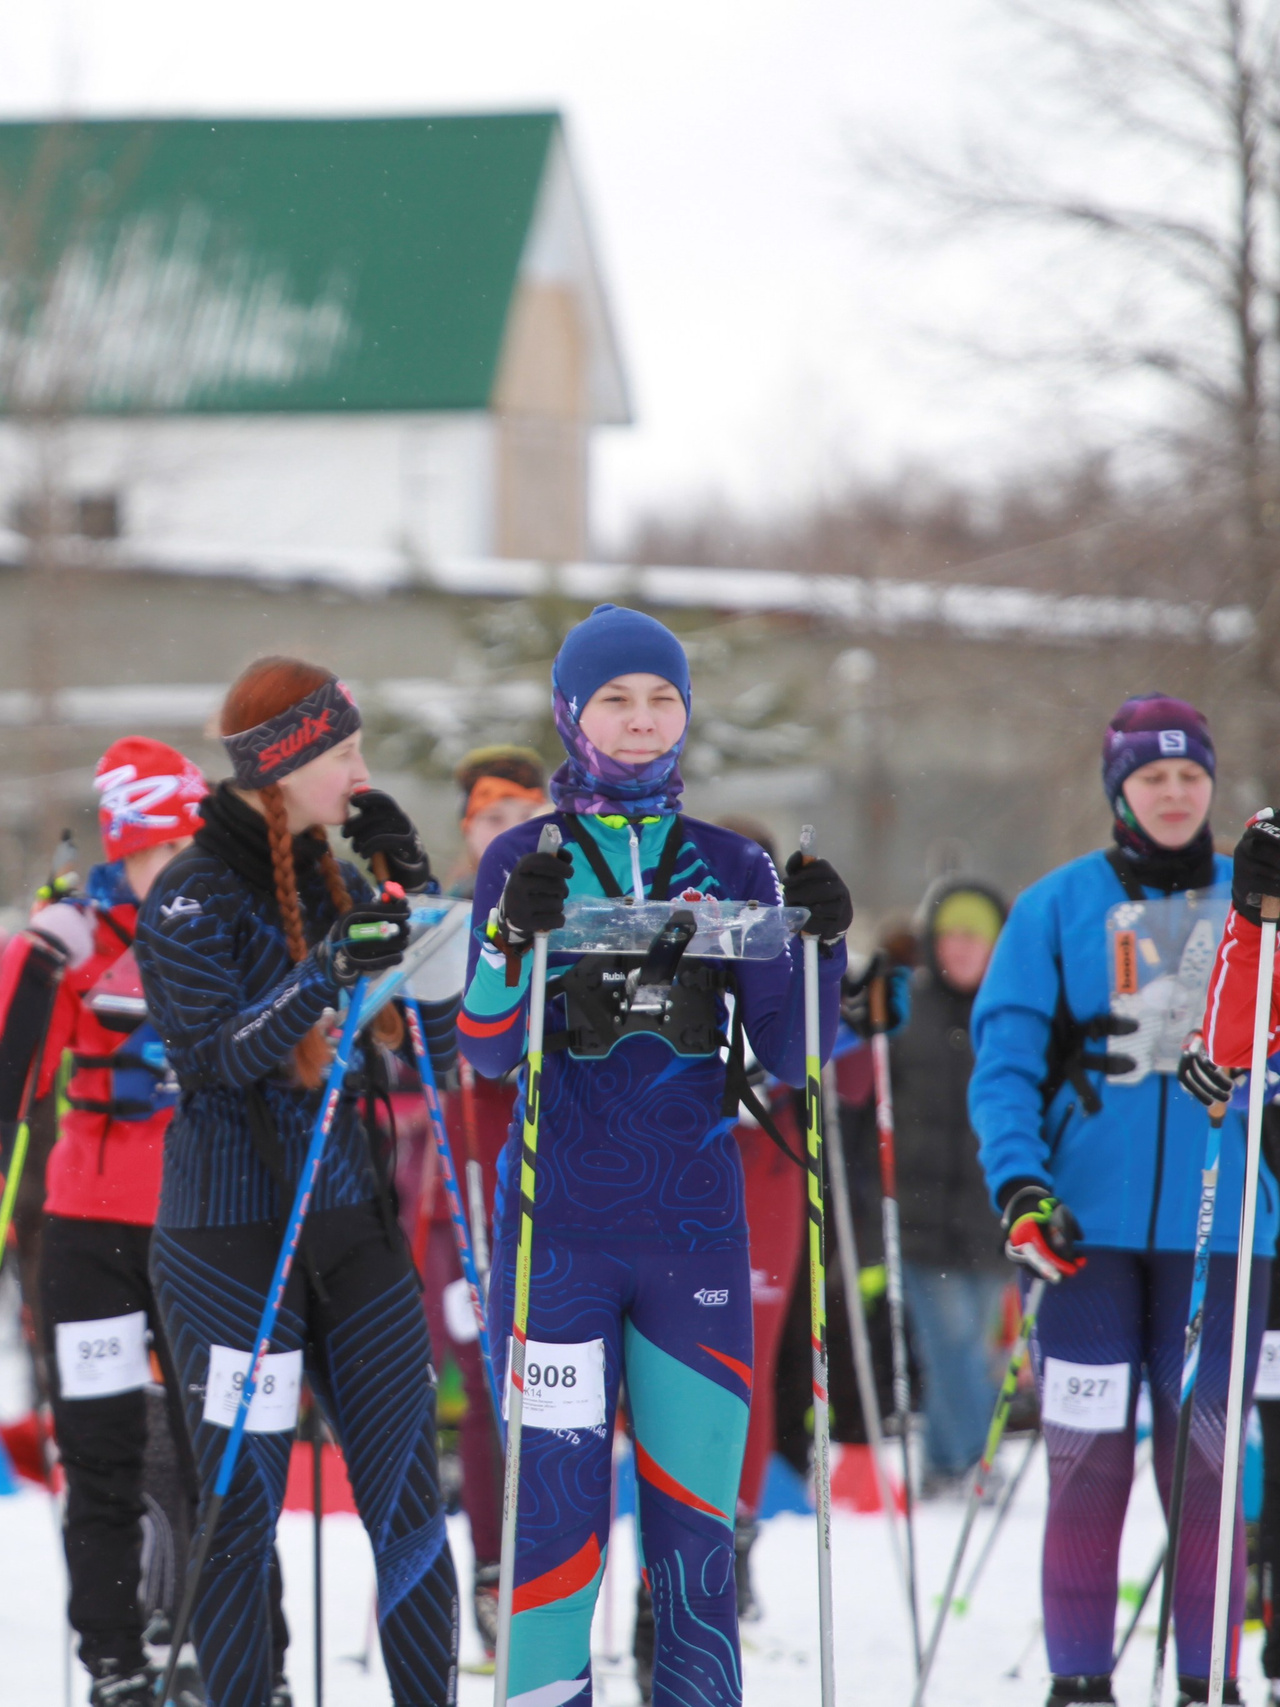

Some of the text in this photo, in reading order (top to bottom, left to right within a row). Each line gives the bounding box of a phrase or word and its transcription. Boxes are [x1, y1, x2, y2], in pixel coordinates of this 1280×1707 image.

[79, 1338, 120, 1360] 928
[233, 1371, 275, 1394] 98
[527, 1363, 577, 1388] 908
[1068, 1376, 1110, 1397] 927
